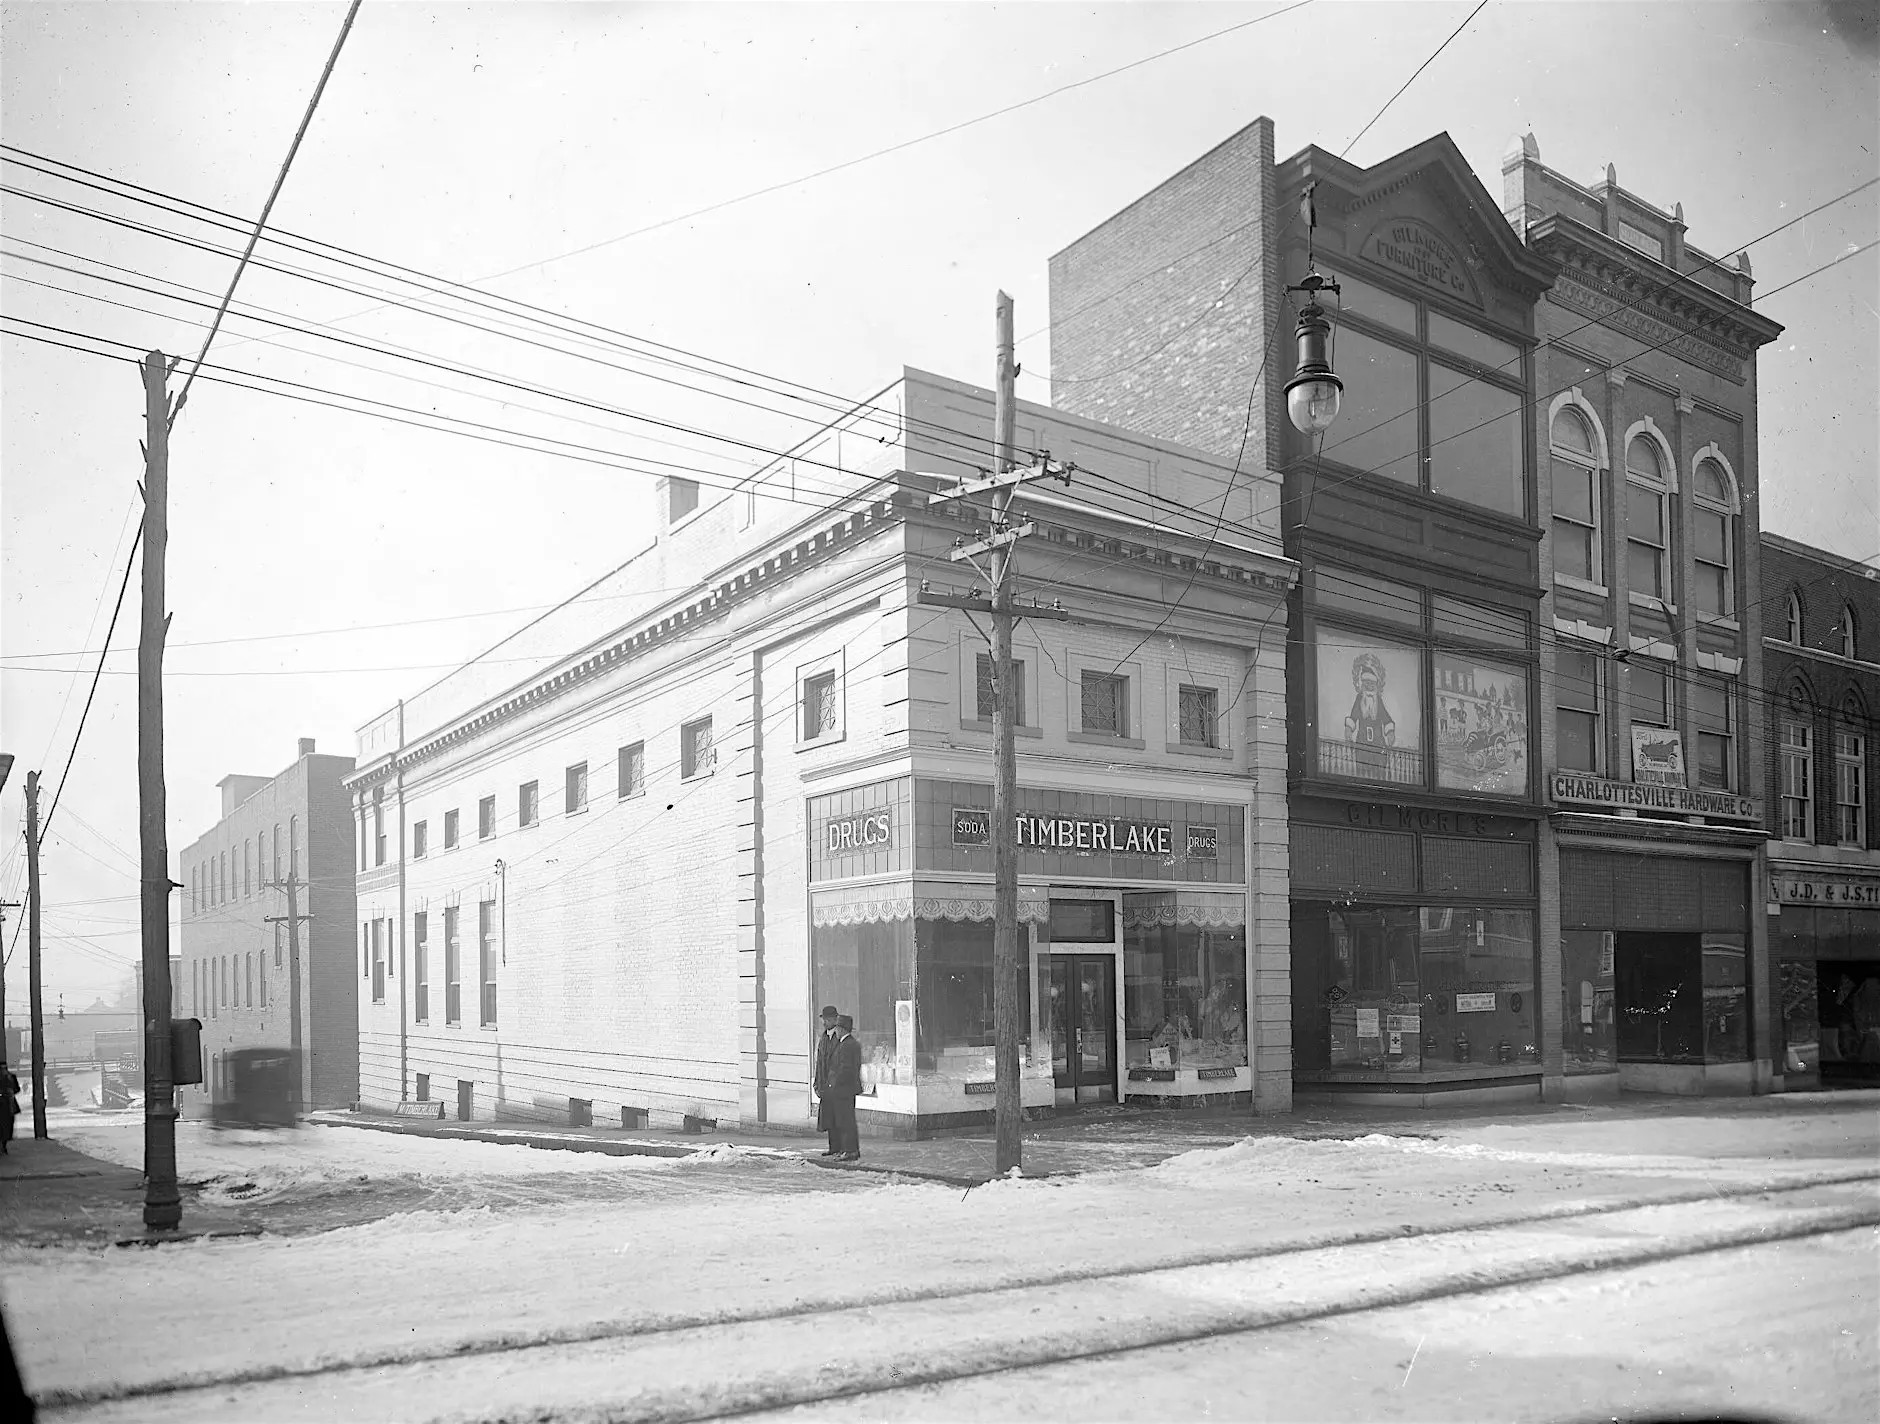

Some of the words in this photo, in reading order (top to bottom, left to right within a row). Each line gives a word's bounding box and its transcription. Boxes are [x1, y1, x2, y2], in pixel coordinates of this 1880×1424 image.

[1377, 240, 1447, 284] FURNITURE
[1555, 778, 1675, 807] CHARLOTTESVILLE
[1680, 791, 1736, 815] HARDWARE
[829, 814, 890, 851] DRUGS
[957, 820, 987, 835] SODA
[1016, 817, 1171, 853] TIMBERLAKE
[1188, 836, 1216, 849] DRUGS
[1790, 882, 1817, 899] J.D.
[1825, 885, 1835, 900] &
